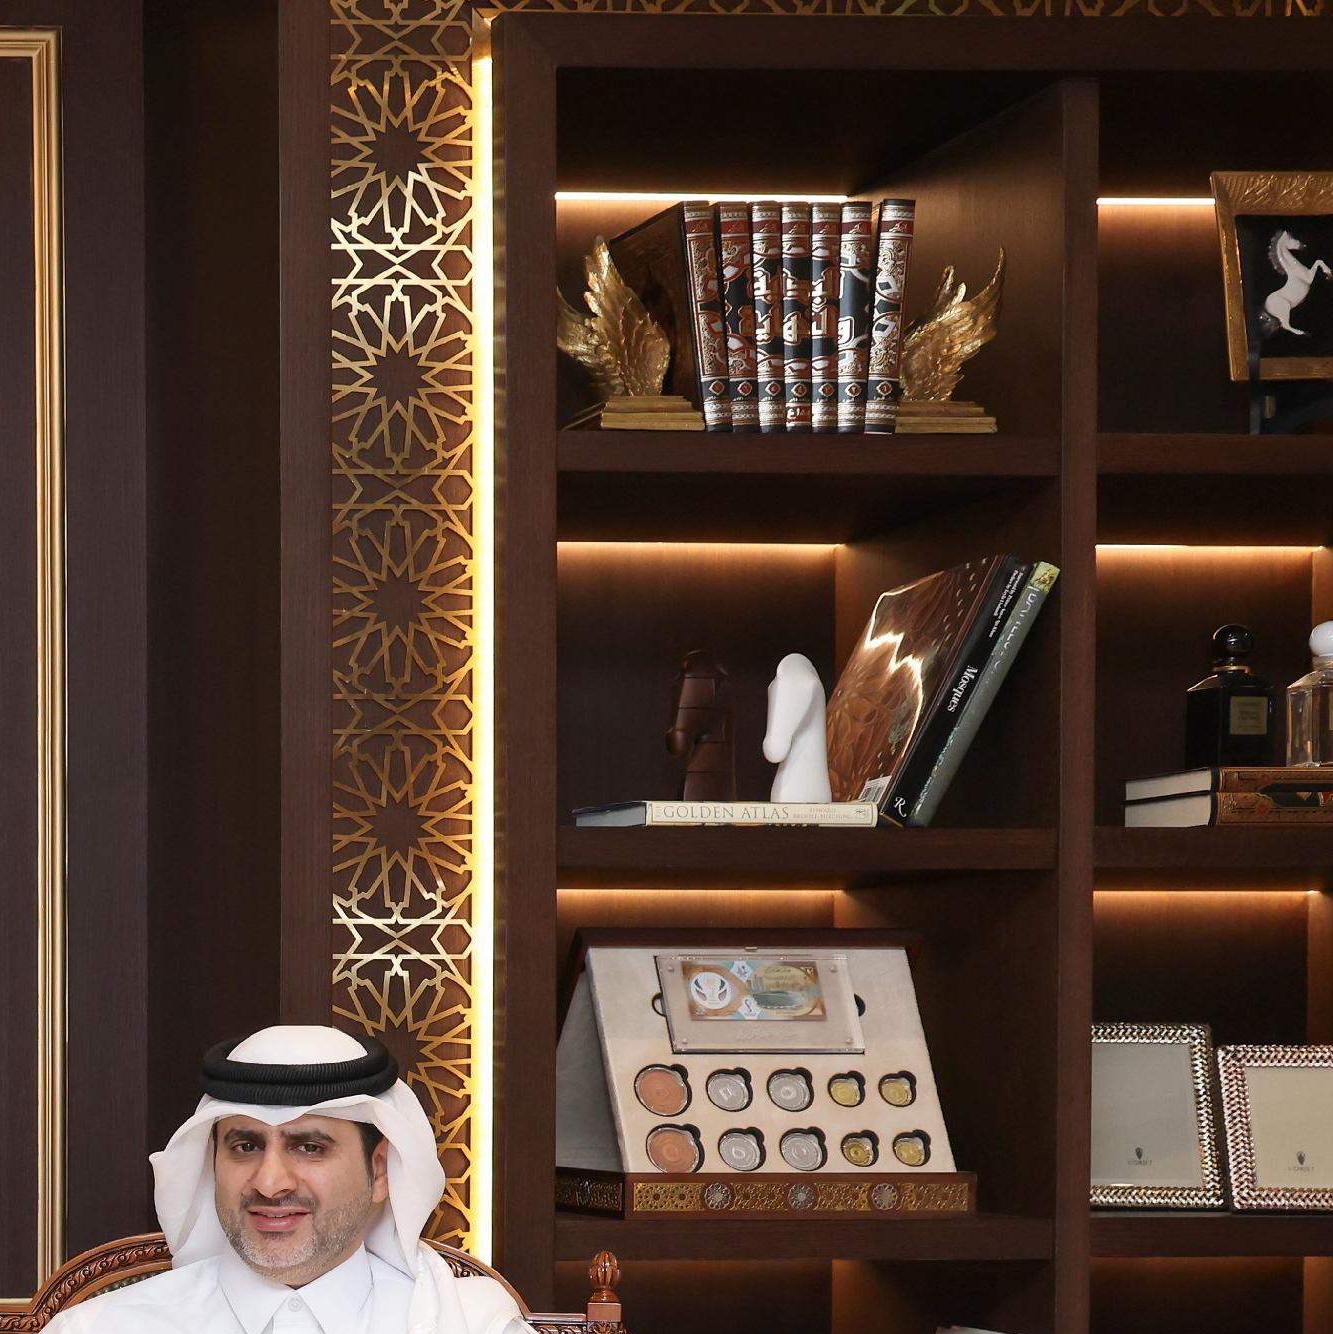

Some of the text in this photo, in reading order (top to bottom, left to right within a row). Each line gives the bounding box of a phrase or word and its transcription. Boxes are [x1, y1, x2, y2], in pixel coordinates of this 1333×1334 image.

[947, 664, 979, 713] Mosques
[663, 805, 790, 820] GOLDEN ATLAS
